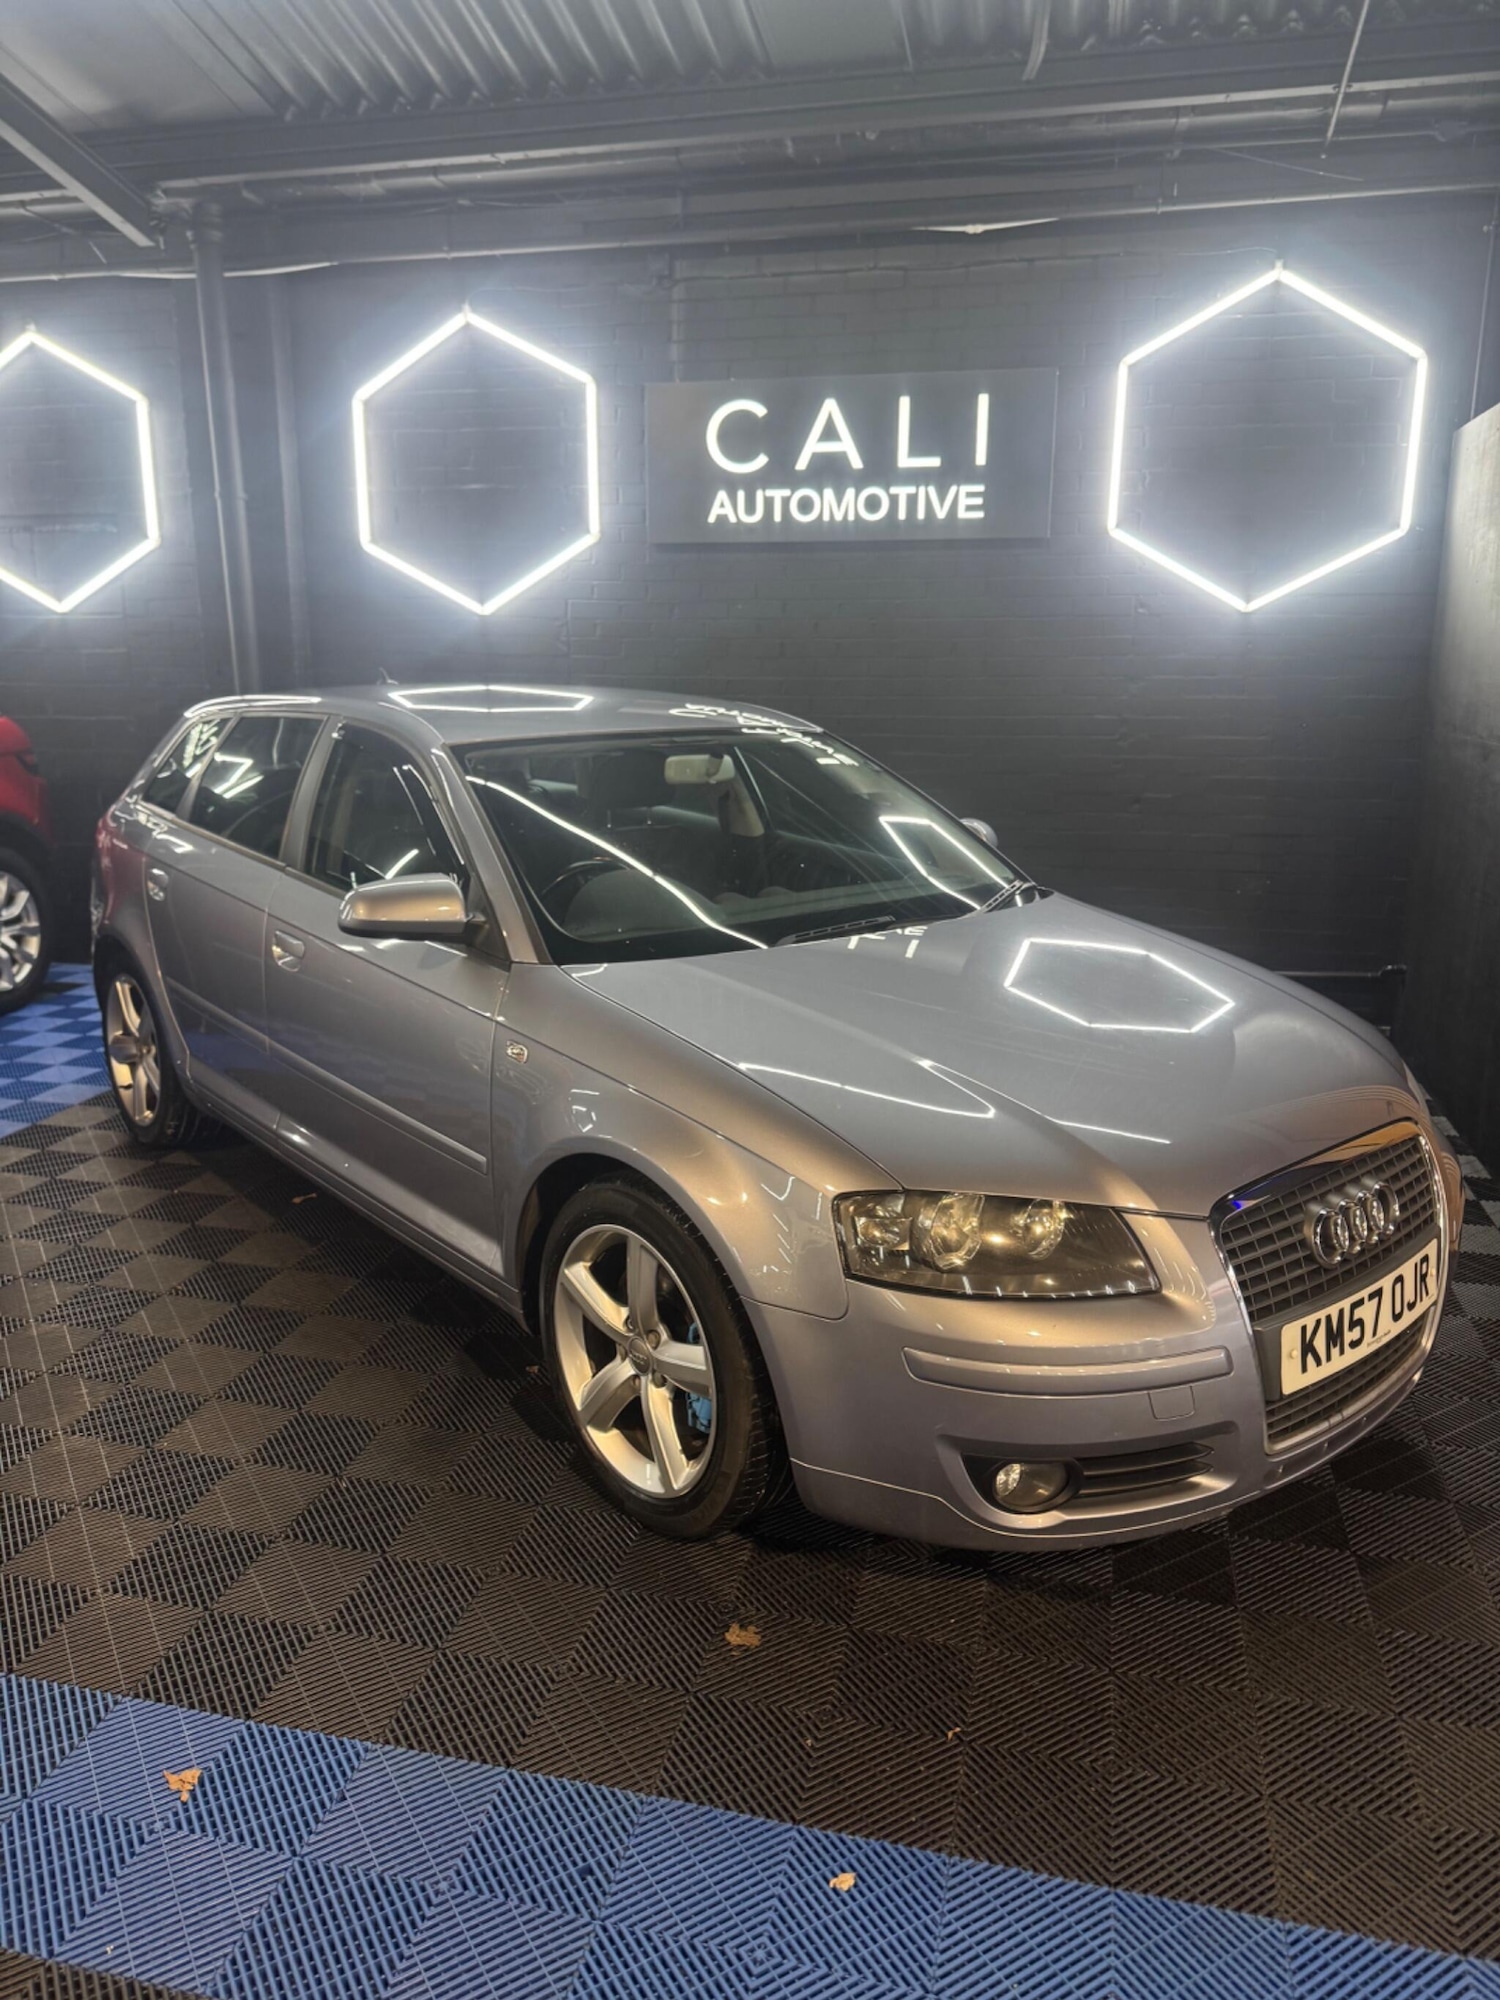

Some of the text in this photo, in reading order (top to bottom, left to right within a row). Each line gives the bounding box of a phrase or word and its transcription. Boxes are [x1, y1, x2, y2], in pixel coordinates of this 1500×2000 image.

[706, 393, 990, 474] CALI
[707, 484, 985, 523] AUTOMOTIVE
[1301, 1253, 1429, 1374] KM57 OJR
